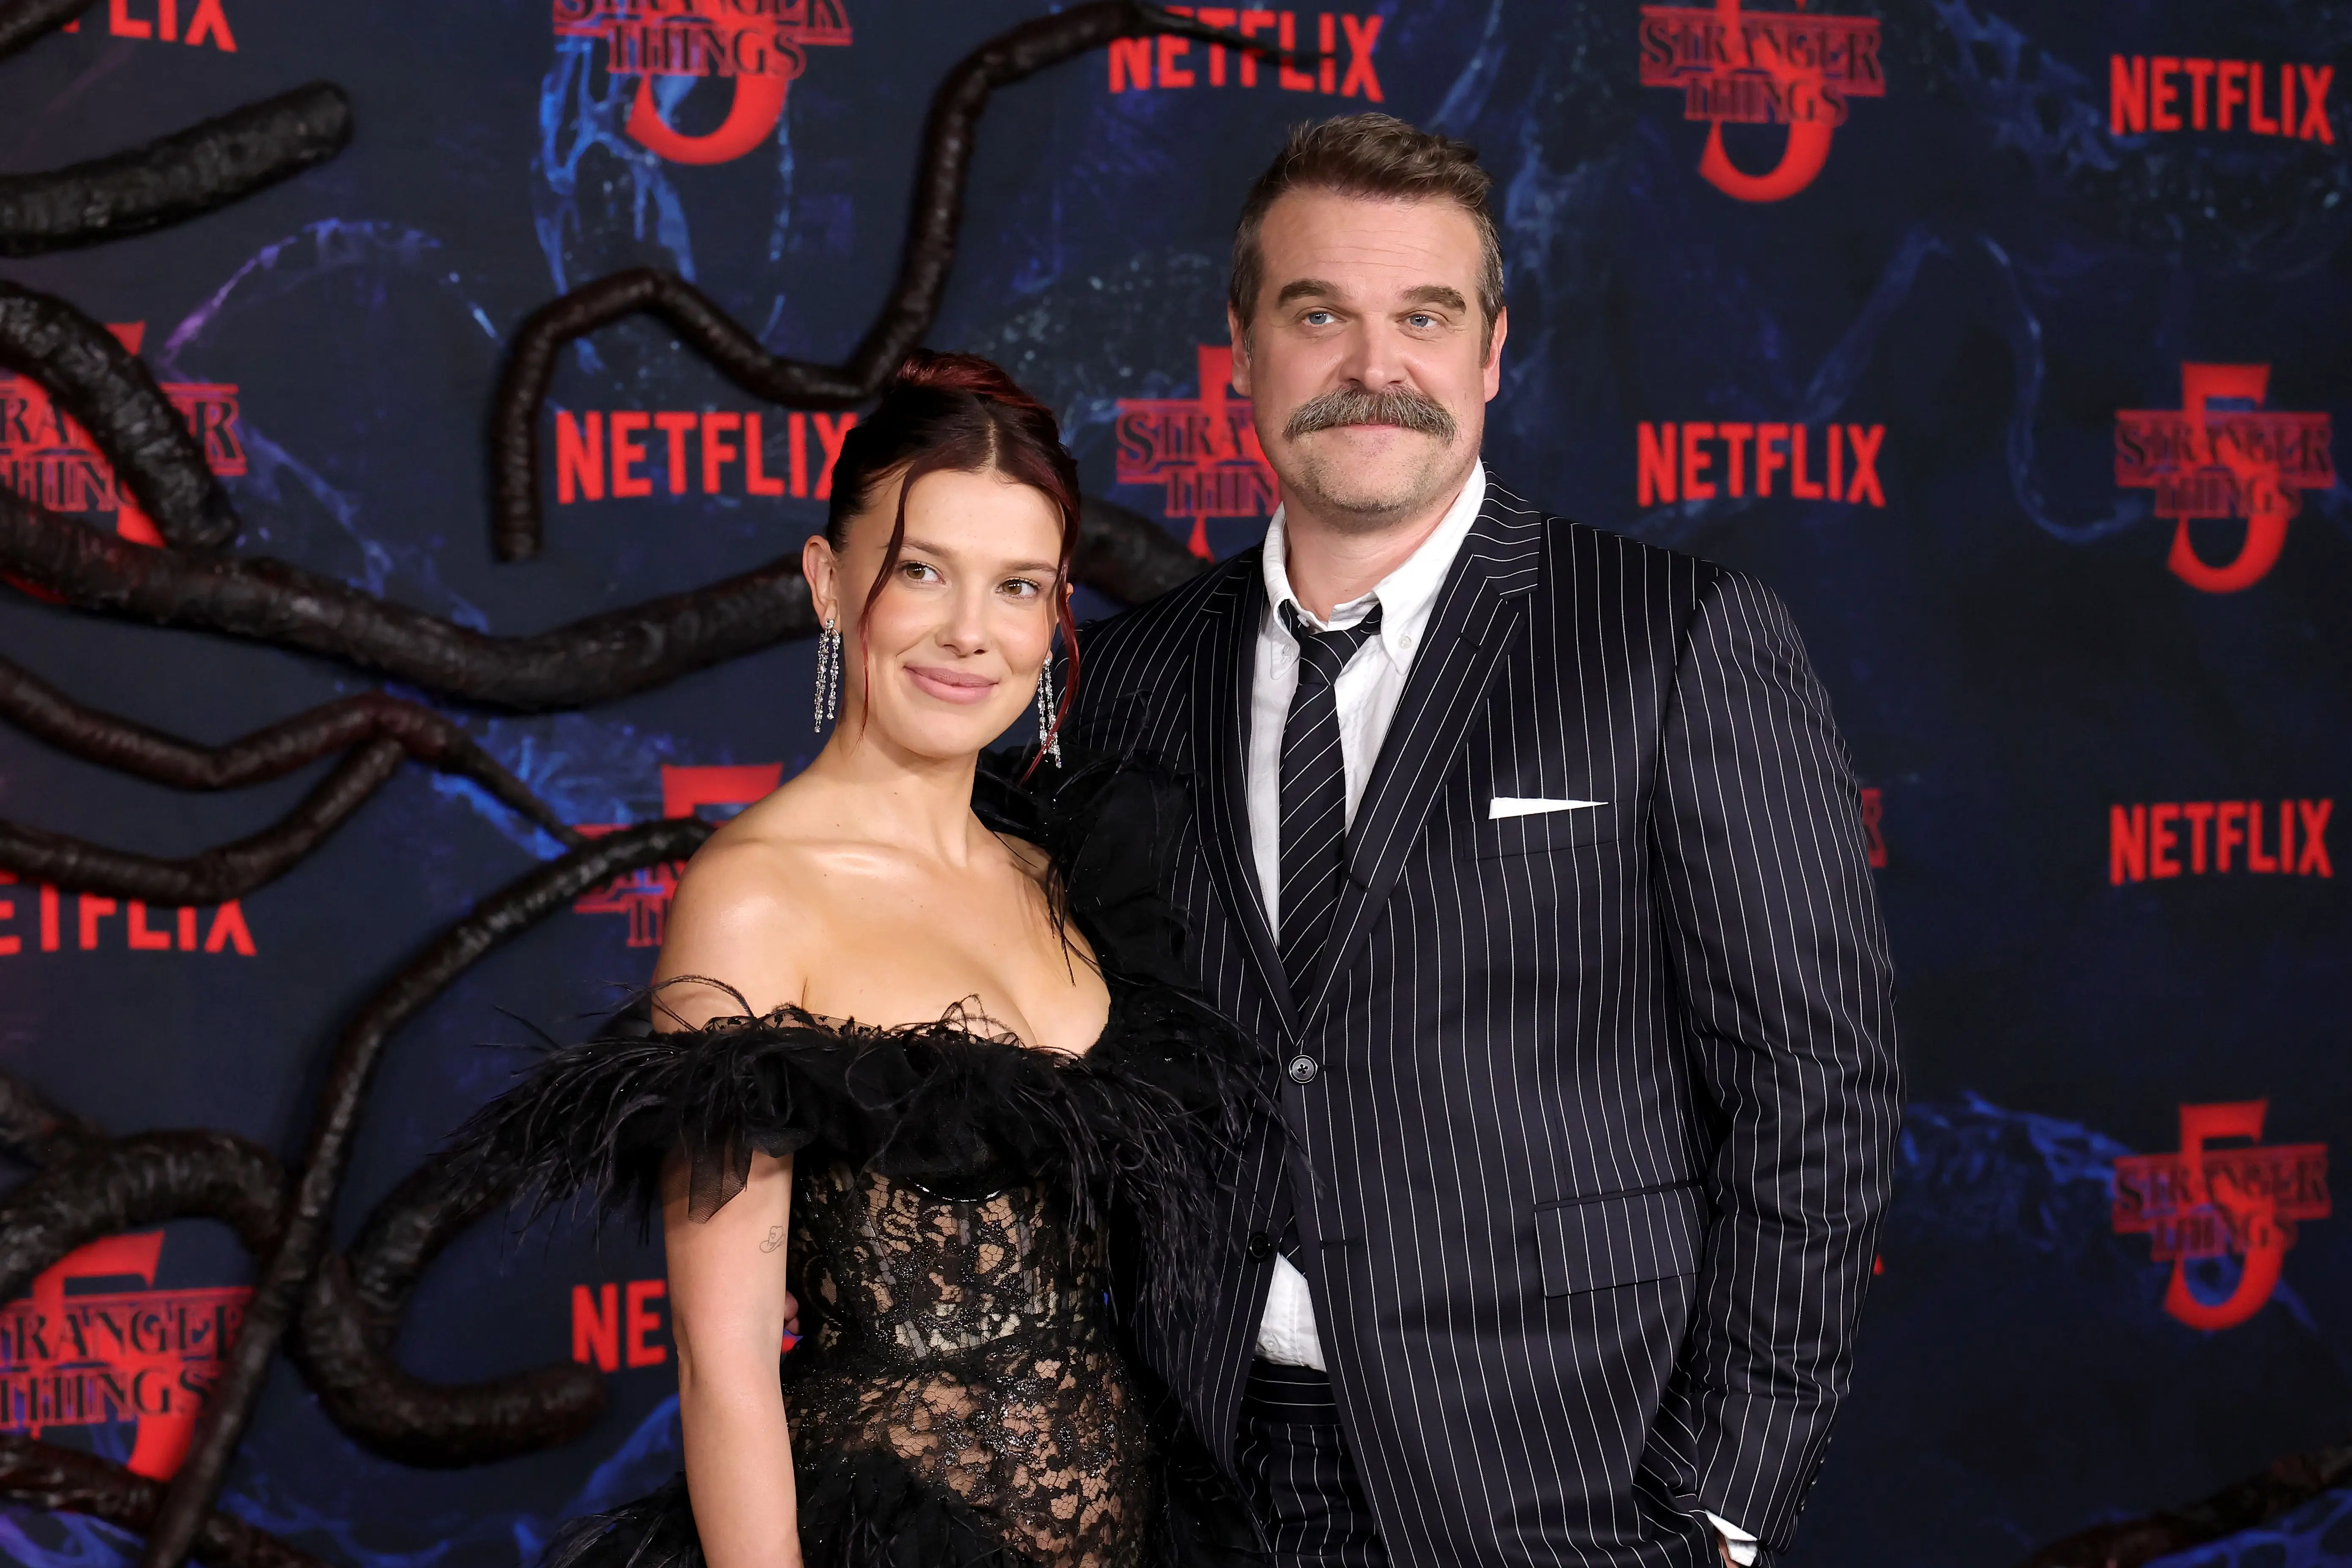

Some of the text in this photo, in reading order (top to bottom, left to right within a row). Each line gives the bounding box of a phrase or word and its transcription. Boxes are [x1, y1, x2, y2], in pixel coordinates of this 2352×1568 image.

[605, 25, 807, 79] THINGS
[1108, 5, 1385, 103] NETFLIX
[2110, 53, 2335, 145] NETFLIX
[555, 410, 859, 505] NETFLIX
[1164, 466, 1283, 517] THIN
[1637, 421, 1886, 507] NETFLIX
[2168, 362, 2290, 593] 5
[2109, 798, 2333, 886] NETFLIX
[2163, 1099, 2285, 1331] 5
